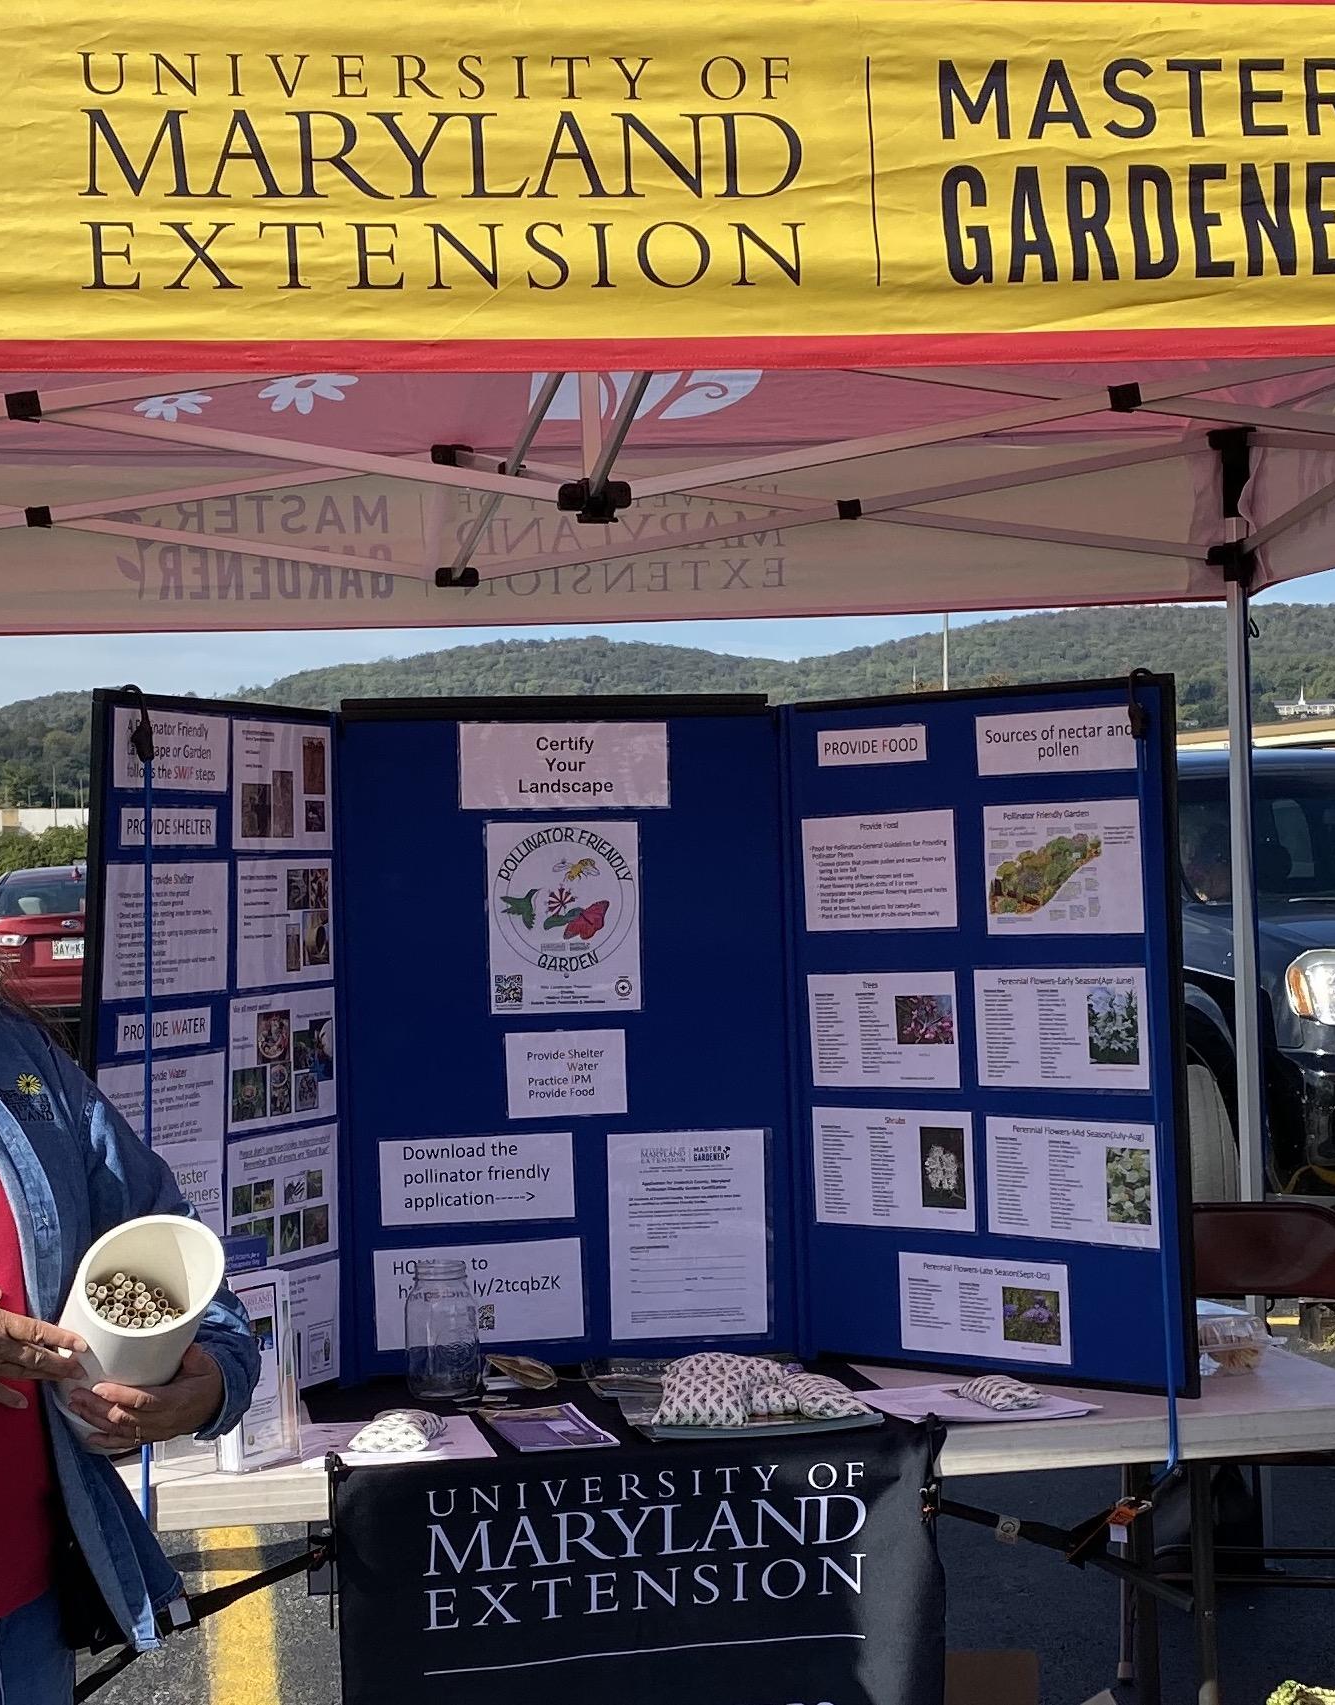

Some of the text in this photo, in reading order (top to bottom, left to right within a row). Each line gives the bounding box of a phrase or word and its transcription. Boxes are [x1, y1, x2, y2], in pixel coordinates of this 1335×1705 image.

[79, 51, 791, 100] UNIVERSITY OF
[79, 109, 802, 199] MARYLAND
[83, 221, 804, 290] EXTENSION
[135, 719, 175, 735] Pinator
[985, 723, 1133, 744] Sources of nectar and
[127, 743, 170, 758] Laape
[183, 745, 211, 760] Garden
[536, 736, 594, 754] Certify
[824, 738, 918, 756] PROVIDE FOOD
[1038, 743, 1079, 761] pollen
[127, 763, 155, 778] follos
[157, 764, 172, 778] the
[545, 758, 586, 772] Your
[519, 779, 614, 796] Landscape
[1003, 809, 1090, 820] Pollinator Friendly Garden
[173, 819, 212, 835] SHELTER
[498, 827, 634, 881] POLLINATOR FRIENDLY
[538, 951, 599, 972] GARDEN
[862, 981, 878, 989] Trees
[123, 1017, 206, 1041] PROIDE WATER
[527, 1049, 604, 1061] Provide Shelter
[567, 1061, 599, 1071] Water
[528, 1074, 592, 1086] Practice IPM
[529, 1087, 595, 1100] Provide Food
[1012, 1125, 1043, 1134] Perennial
[403, 1142, 518, 1161] Download the
[693, 1152, 724, 1162] GARDENER
[404, 1164, 550, 1187] pollinator friendly
[180, 1186, 220, 1201] deners
[471, 1257, 488, 1271] to
[428, 1460, 864, 1517] UNIVERSITY OF
[424, 1495, 865, 1575] MARYLAND
[424, 1553, 865, 1632] EXTENSION
